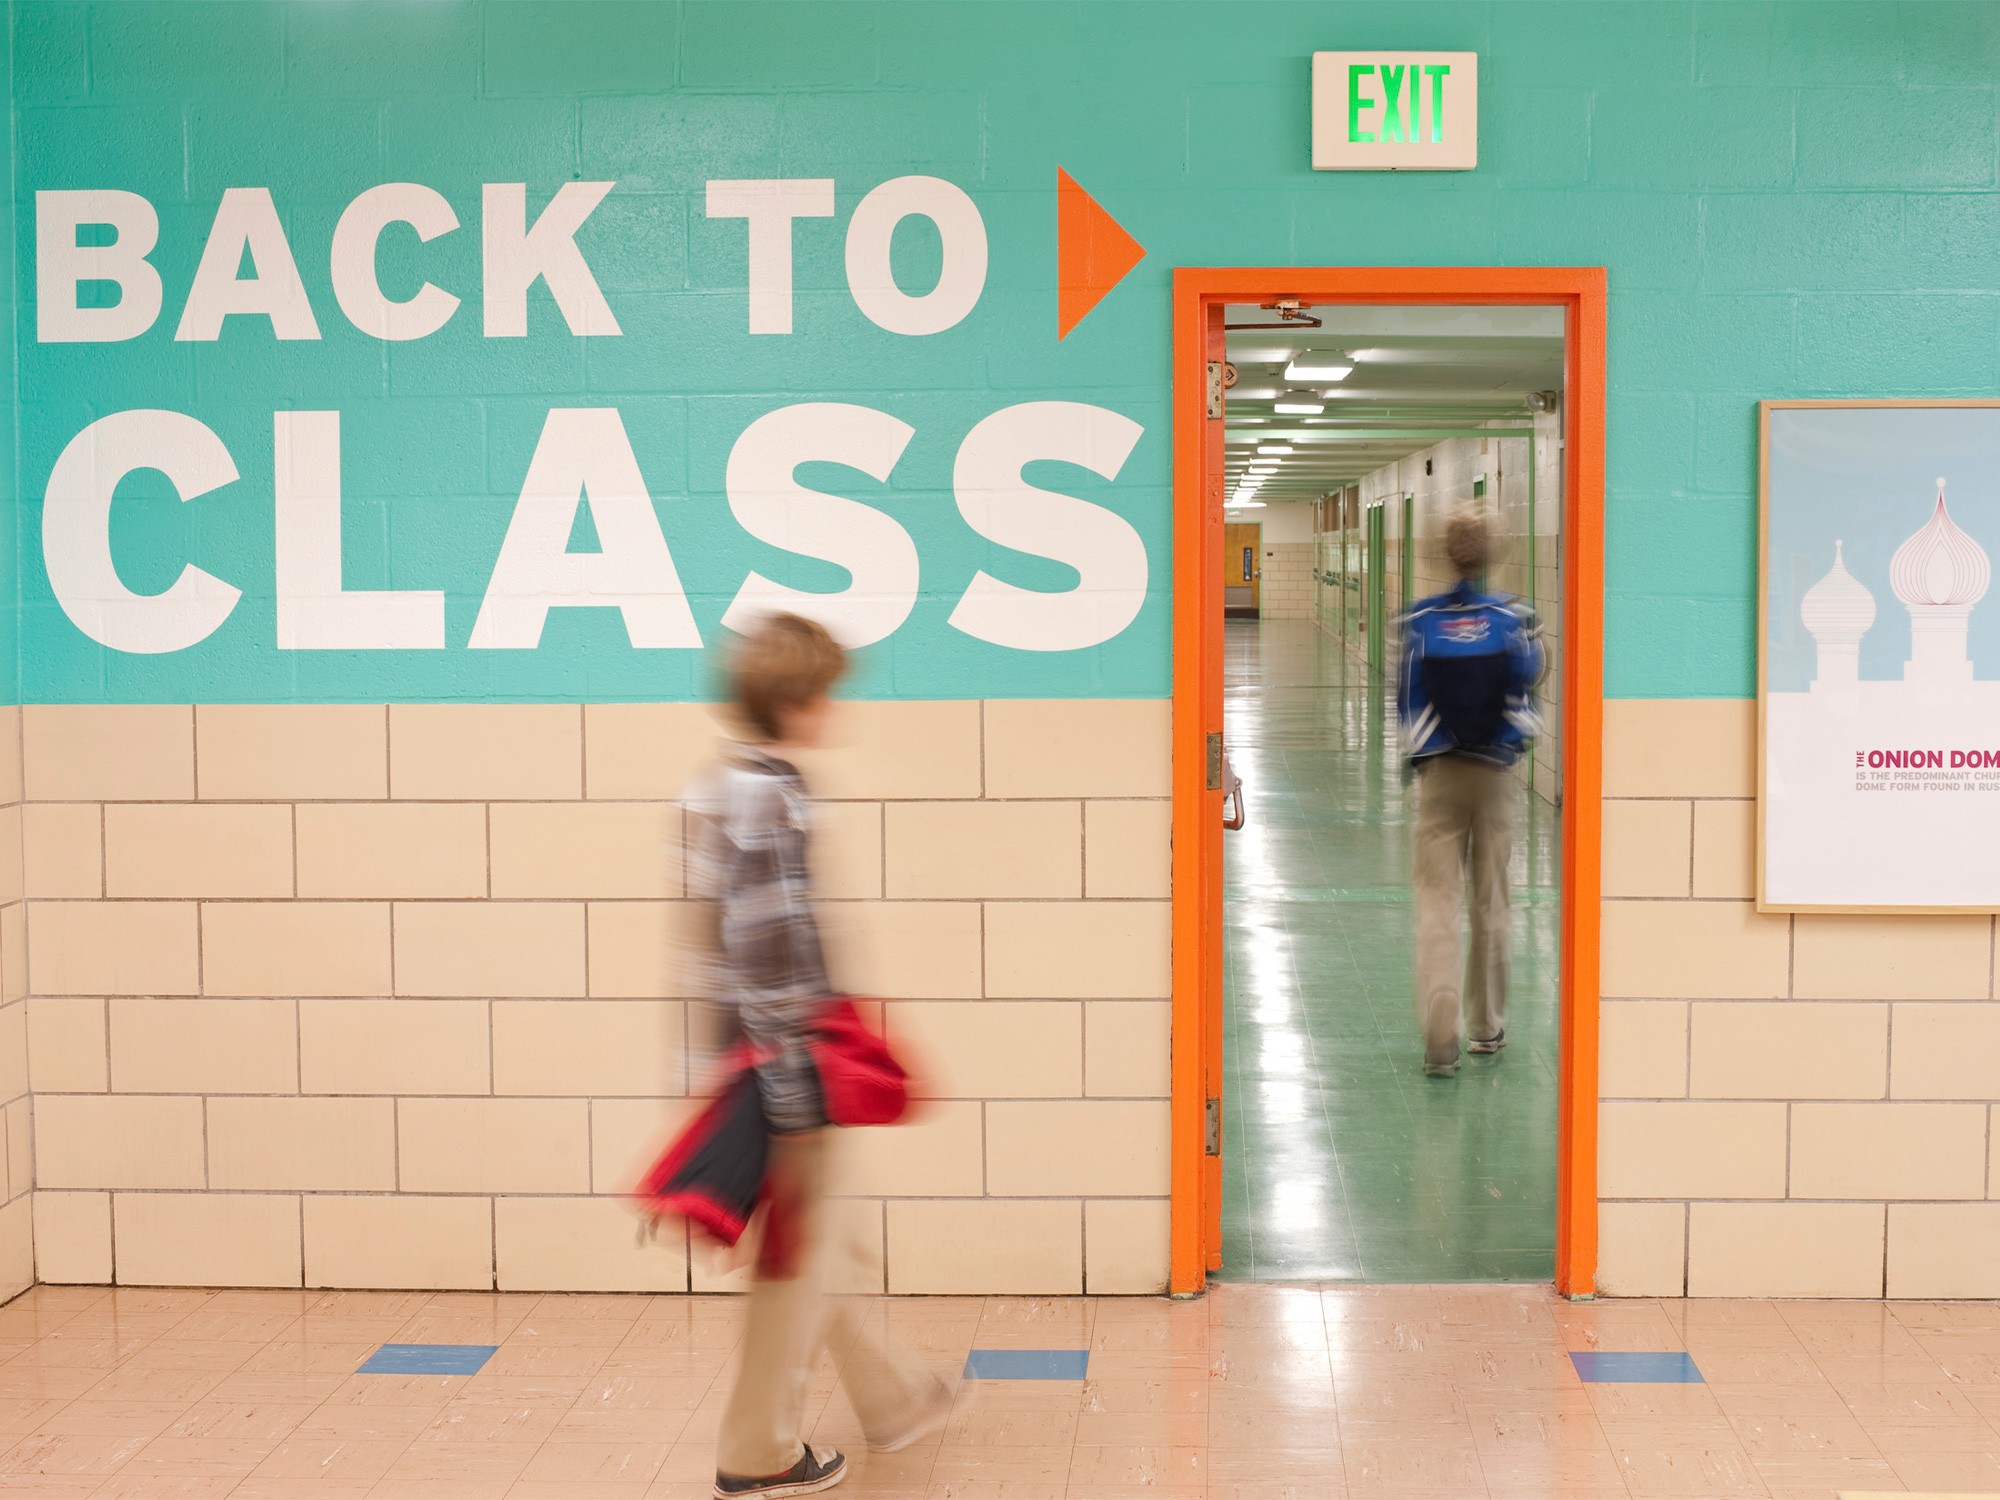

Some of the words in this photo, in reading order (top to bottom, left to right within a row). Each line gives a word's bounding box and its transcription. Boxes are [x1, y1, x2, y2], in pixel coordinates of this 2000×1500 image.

[1348, 64, 1451, 143] EXIT
[35, 180, 624, 344] BACK
[704, 175, 990, 336] TO
[41, 400, 1149, 655] CLASS
[1856, 750, 1865, 768] THE
[1867, 749, 1944, 769] ONION
[1950, 749, 2000, 769] DOM
[1856, 771, 1866, 781] IS
[1869, 771, 1891, 781] THE
[1893, 771, 1971, 781] PREDOMINANT
[1855, 782, 1886, 792] DOME
[1889, 782, 1920, 792] FORM
[1923, 782, 1960, 792] FOUND
[1964, 782, 1975, 792] IN
[1978, 782, 2000, 792] RUS
